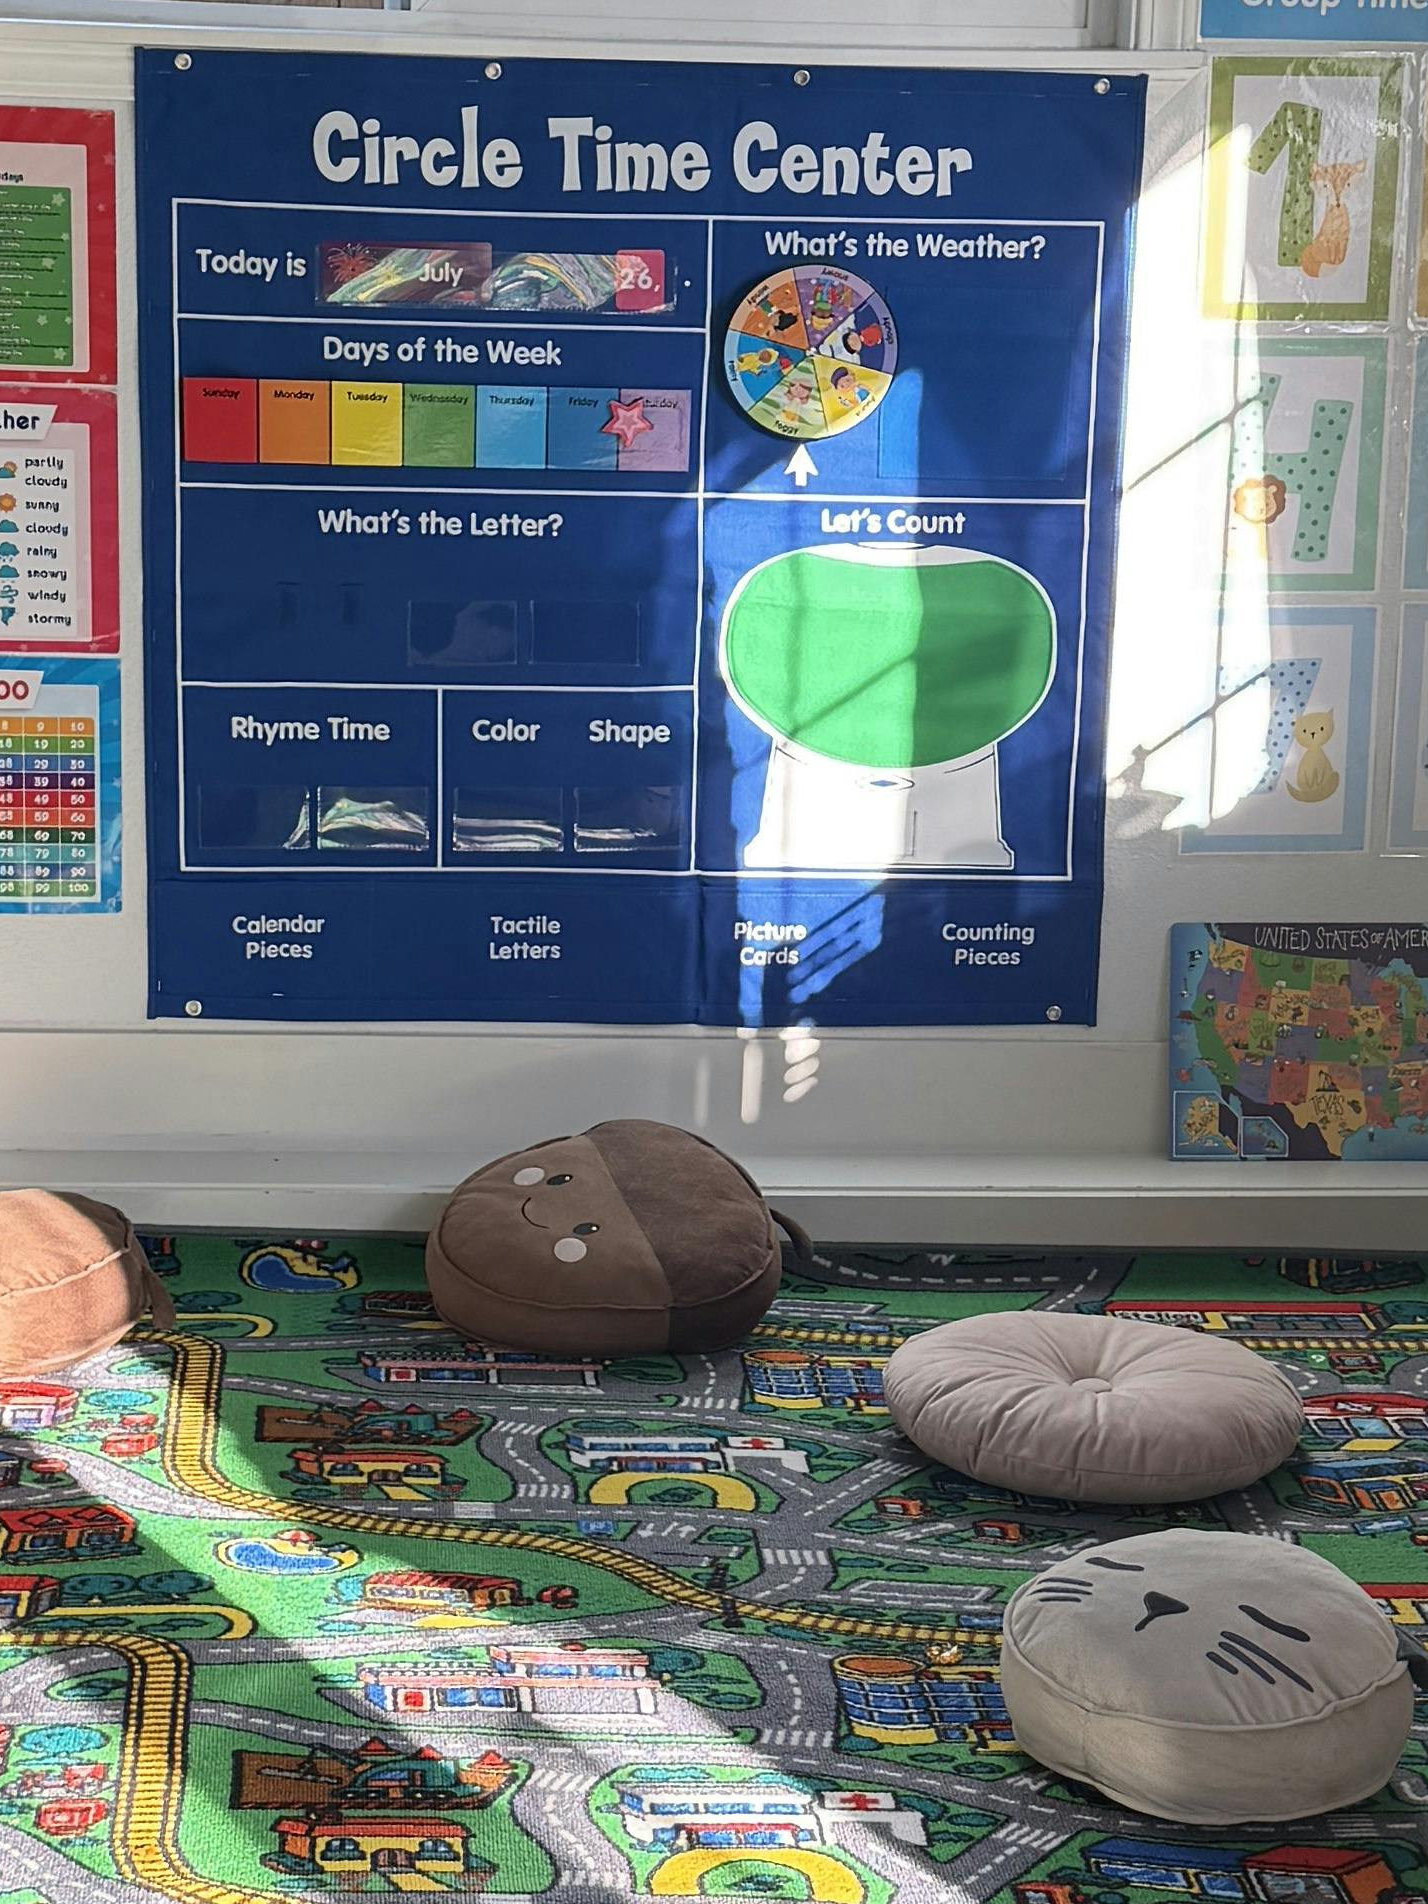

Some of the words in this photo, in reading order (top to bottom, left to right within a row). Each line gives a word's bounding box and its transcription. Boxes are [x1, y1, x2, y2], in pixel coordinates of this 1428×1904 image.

[312, 105, 524, 189] Circle
[548, 116, 712, 193] Time
[732, 120, 973, 198] Center
[1247, 101, 1321, 267] 1
[765, 231, 858, 257] What's
[865, 233, 909, 257] the
[917, 234, 1046, 259] Weather?
[195, 248, 278, 282] Today
[286, 250, 307, 278] is
[418, 262, 464, 287] July
[323, 337, 389, 365] Days
[398, 339, 427, 362] of
[434, 339, 479, 364] the
[486, 340, 562, 367] Week
[201, 387, 241, 401] Sunday
[273, 389, 315, 402] Monday
[346, 391, 388, 404] Tuesday
[409, 393, 469, 406] Wednesday
[489, 395, 536, 408] Thursday
[569, 396, 599, 408] Friday
[25, 456, 64, 470] partly
[1231, 371, 1354, 562] 4
[25, 475, 68, 489] cloudy
[25, 500, 60, 512] sunny
[25, 522, 68, 536] cloudy
[317, 509, 411, 536] What's
[417, 511, 463, 536] the
[470, 512, 564, 537] Letter?
[820, 508, 882, 534] Let's
[887, 509, 966, 535] Count
[26, 547, 57, 559] rainy
[27, 568, 67, 581] snowy
[28, 589, 66, 602] windy
[28, 614, 71, 626] stormy
[230, 716, 321, 746] Rhyme
[327, 718, 391, 741] Time
[472, 719, 541, 742] Color
[588, 720, 671, 749] Shape
[232, 914, 325, 936] Calendar
[490, 916, 562, 936] Tactile
[733, 921, 808, 942] Picture
[941, 924, 1035, 945] Counting
[1254, 927, 1310, 950] UNITED
[1313, 927, 1369, 951] STATES
[245, 941, 313, 960] Pieces
[489, 942, 562, 960] Letters
[739, 946, 800, 966] Cards
[954, 948, 1020, 966] Pieces
[1312, 1095, 1345, 1116] TEXAS
